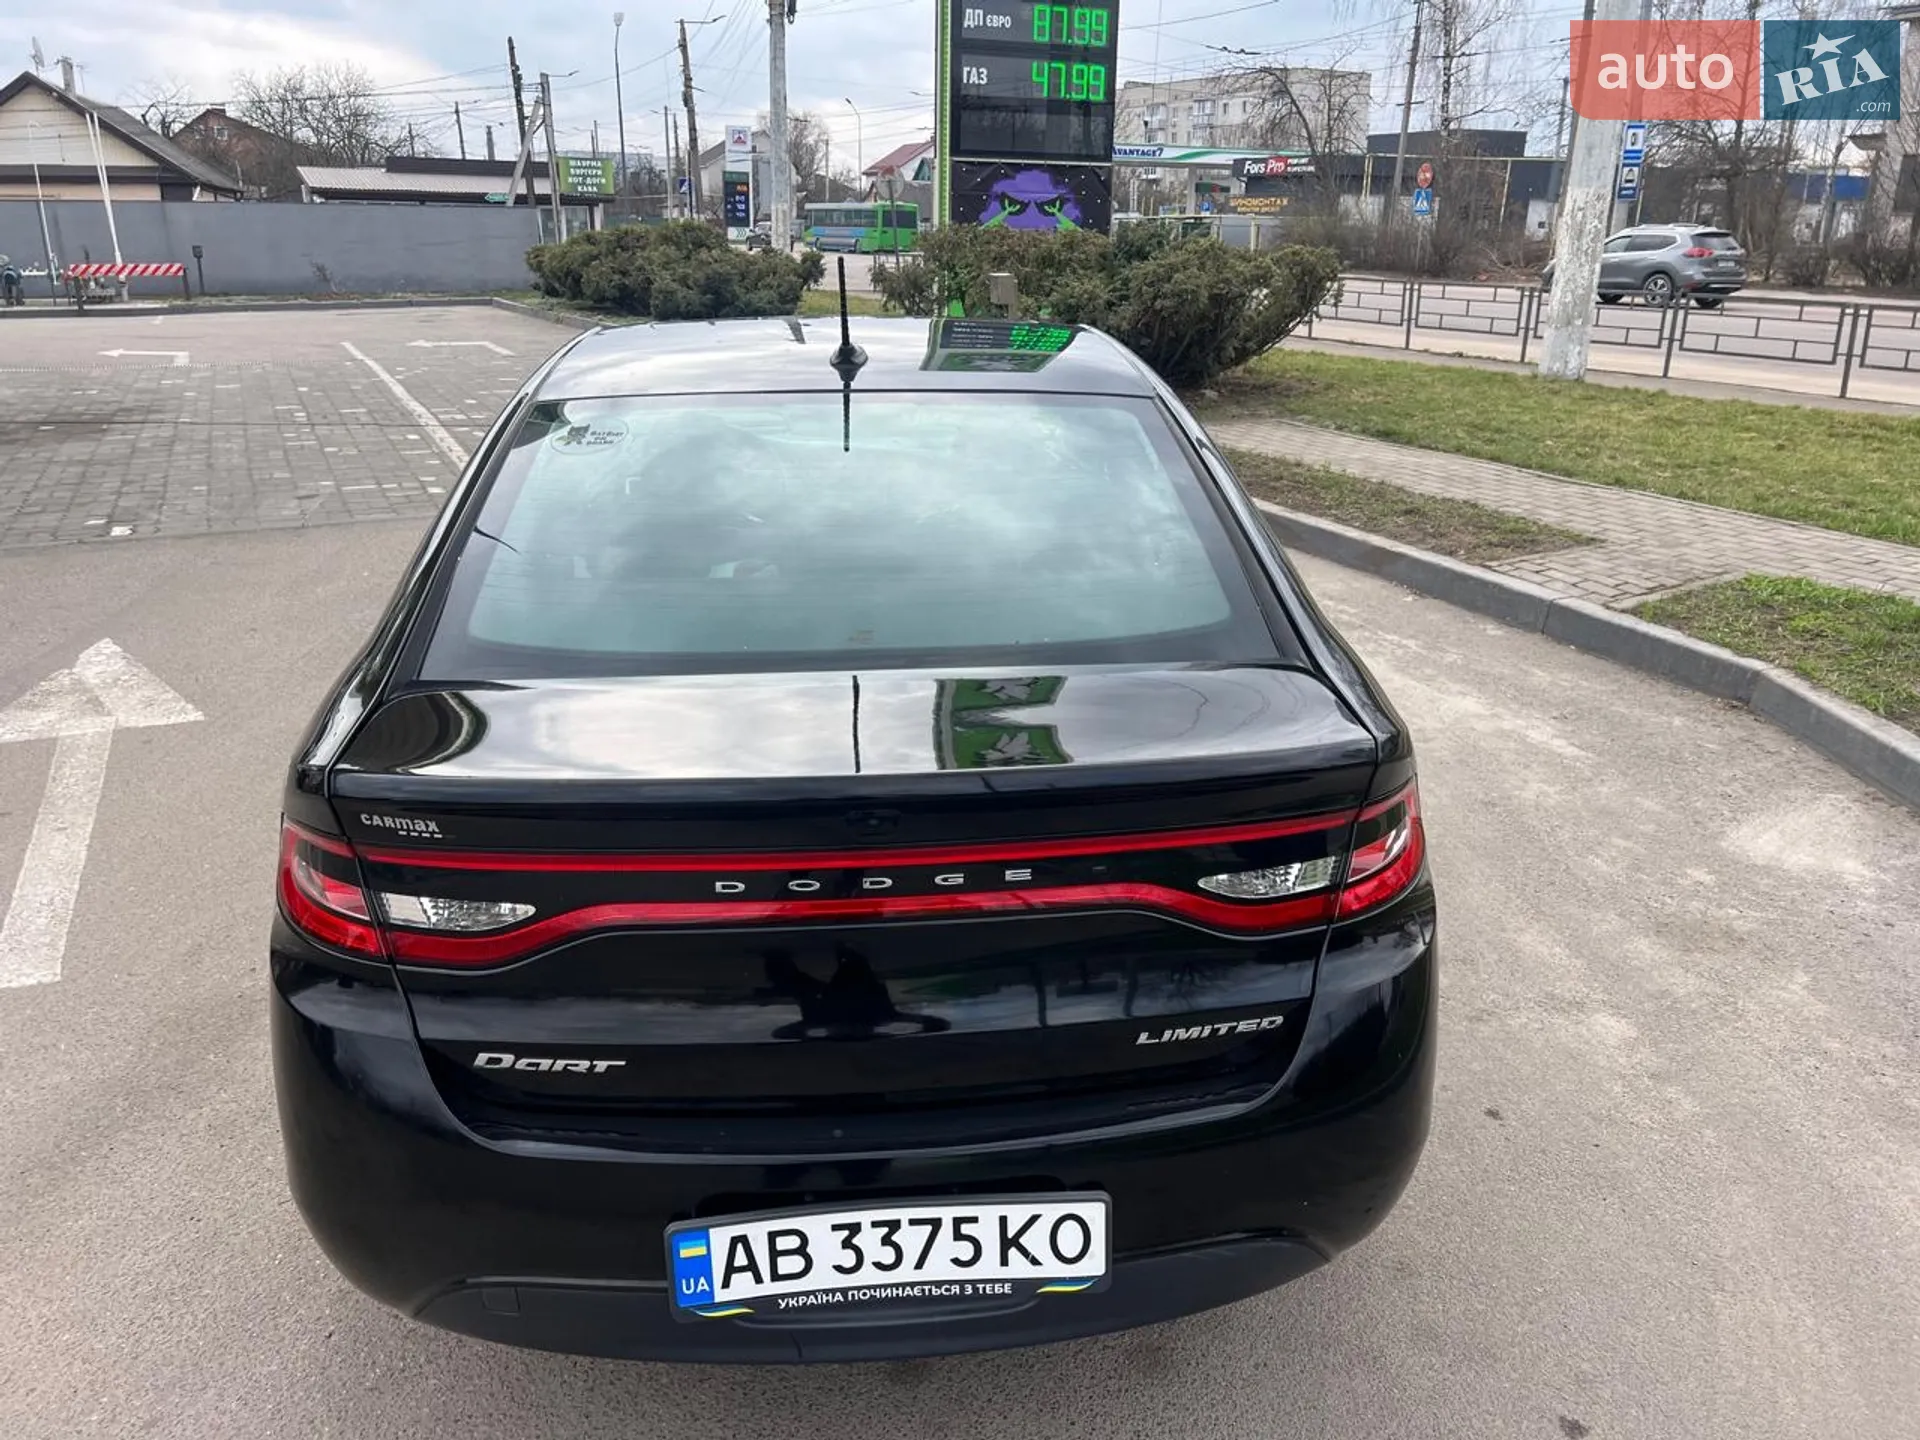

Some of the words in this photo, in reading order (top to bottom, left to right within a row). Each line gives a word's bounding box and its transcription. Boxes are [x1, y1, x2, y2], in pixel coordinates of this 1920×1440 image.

[964, 9, 983, 28] ДП
[1033, 4, 1109, 46] 87.99
[962, 66, 988, 85] ГАЗ
[1031, 61, 1106, 101] 47.99
[1244, 160, 1266, 174] Fors
[1266, 159, 1286, 173] Pro
[714, 868, 1032, 893] DODGE
[1135, 1015, 1284, 1045] LIMITED
[721, 1229, 814, 1289] AB
[831, 1216, 983, 1275] 3375
[1000, 1213, 1092, 1267] KO
[682, 1276, 710, 1294] UA
[778, 1290, 844, 1309] УКРАЇНА
[848, 1285, 960, 1300] ПОЧИНАЄТЬСЯ
[976, 1283, 1013, 1294] ТЕБЕ
